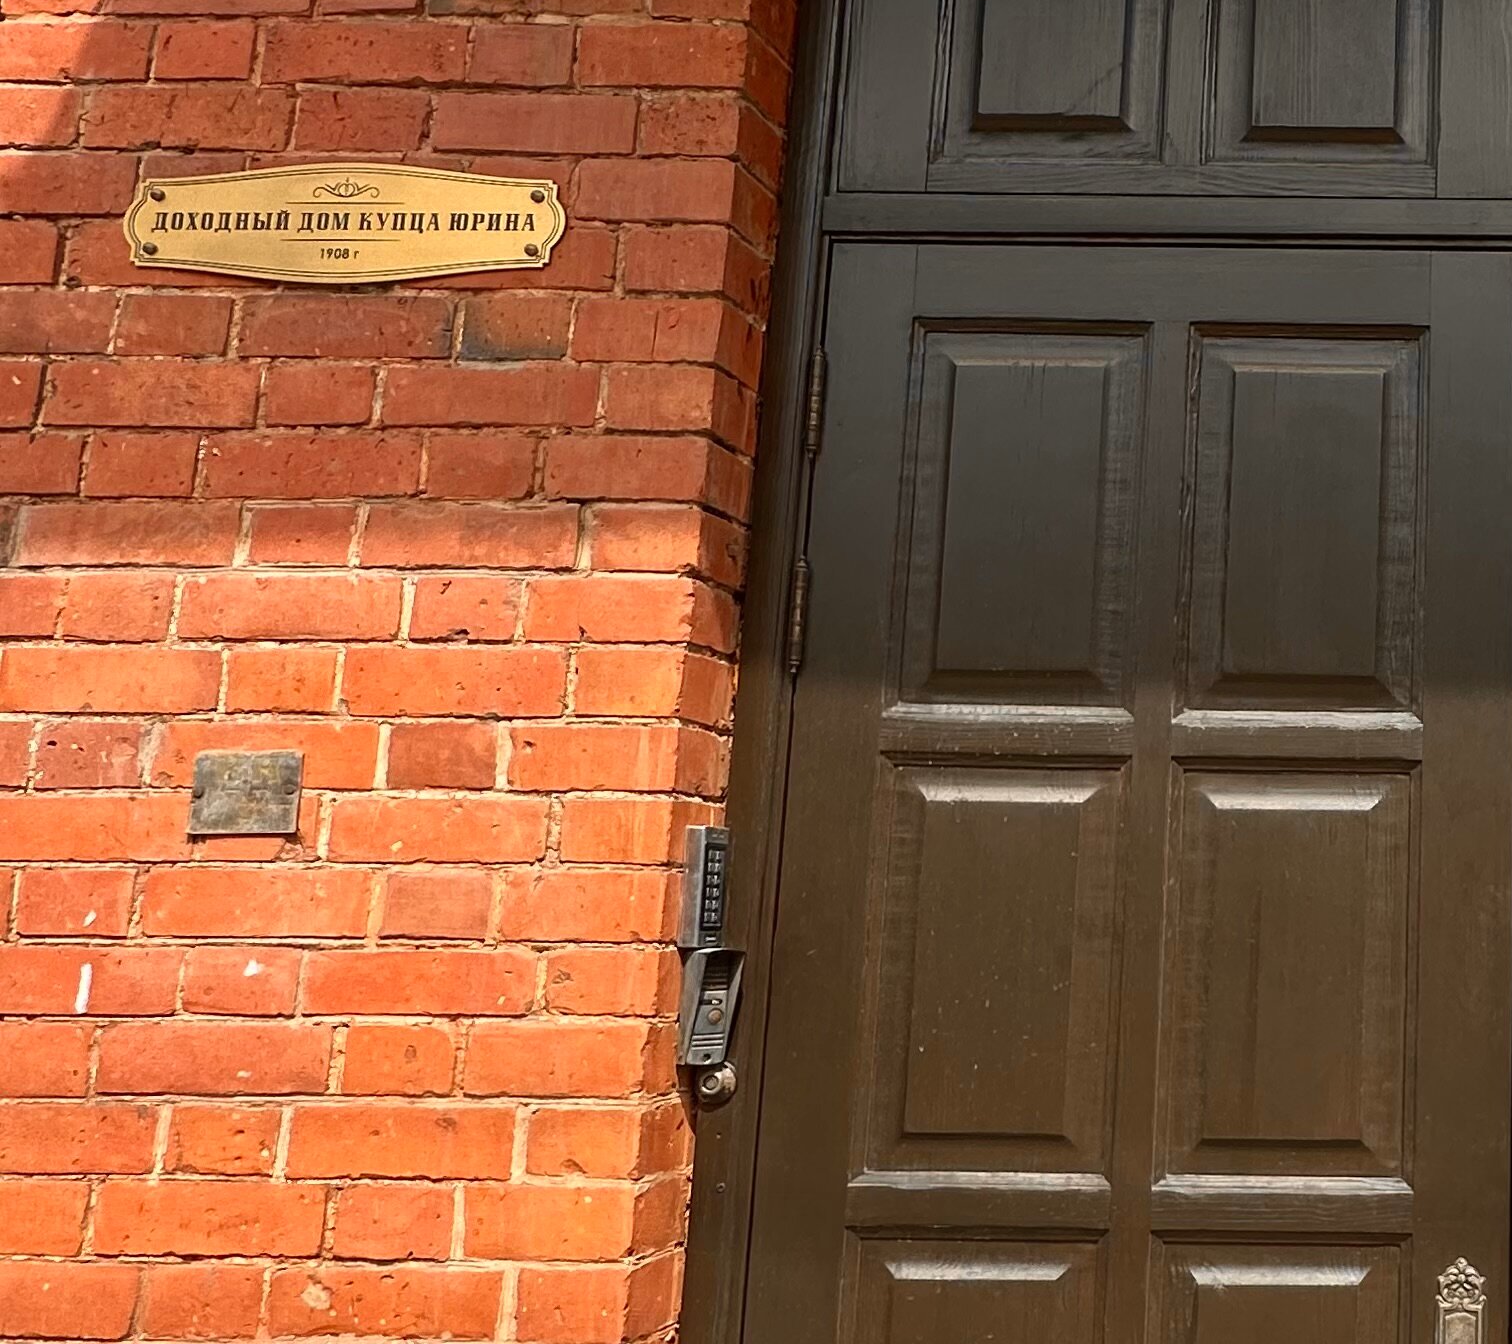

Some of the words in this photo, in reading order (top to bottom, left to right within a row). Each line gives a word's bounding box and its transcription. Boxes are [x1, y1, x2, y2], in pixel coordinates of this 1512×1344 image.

[151, 209, 290, 233] ДОХОДНЫЙ
[297, 211, 349, 233] ДОМ
[358, 211, 440, 234] КУПЦА
[448, 212, 536, 232] ЮРИНА
[319, 247, 350, 260] 1908
